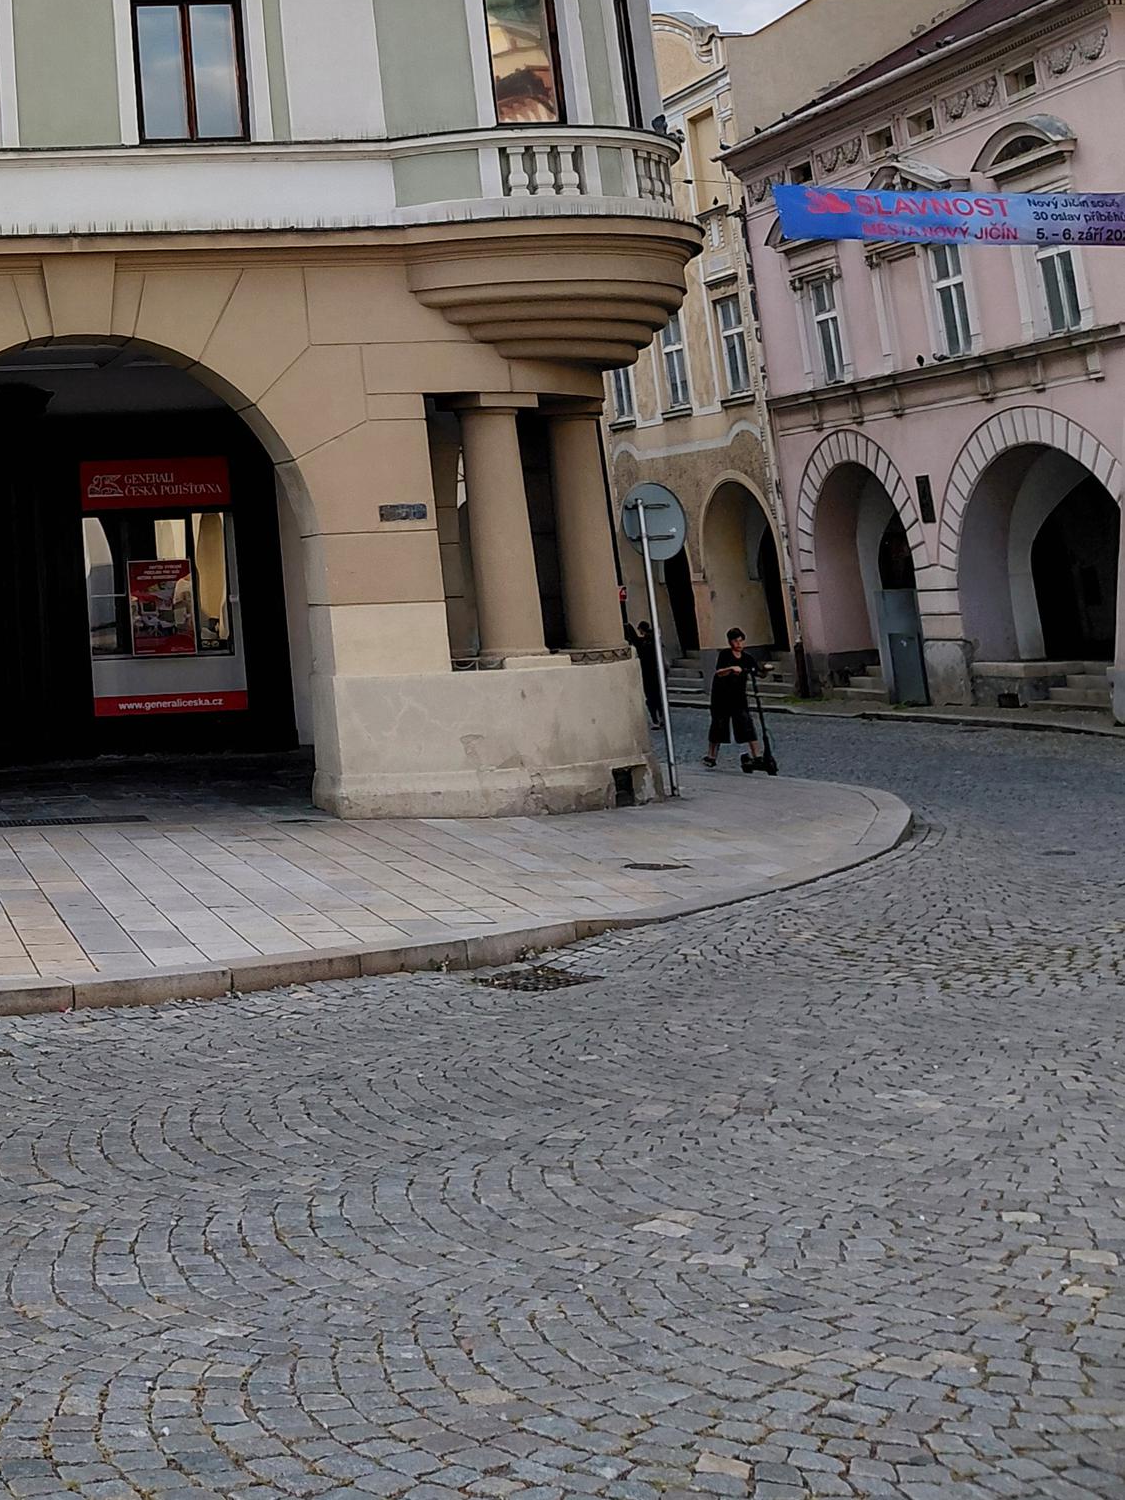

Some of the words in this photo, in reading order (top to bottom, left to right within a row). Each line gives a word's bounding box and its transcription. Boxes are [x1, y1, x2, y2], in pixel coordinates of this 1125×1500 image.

[855, 194, 1009, 217] SLAVNOST
[1026, 197, 1058, 209] Nový
[1032, 211, 1049, 221] 30
[1050, 211, 1081, 221] oslav
[921, 220, 969, 238] NOVÝ
[974, 221, 1018, 240] JIČÍN
[1036, 227, 1049, 241] 5.
[1062, 227, 1075, 241] 6.
[1077, 226, 1105, 241] září
[124, 473, 174, 484] GENERALI
[124, 483, 157, 496] ČESKÁ
[161, 482, 222, 496] POJIŠŤOVNA
[118, 697, 224, 711] www.generaliceska.cz
